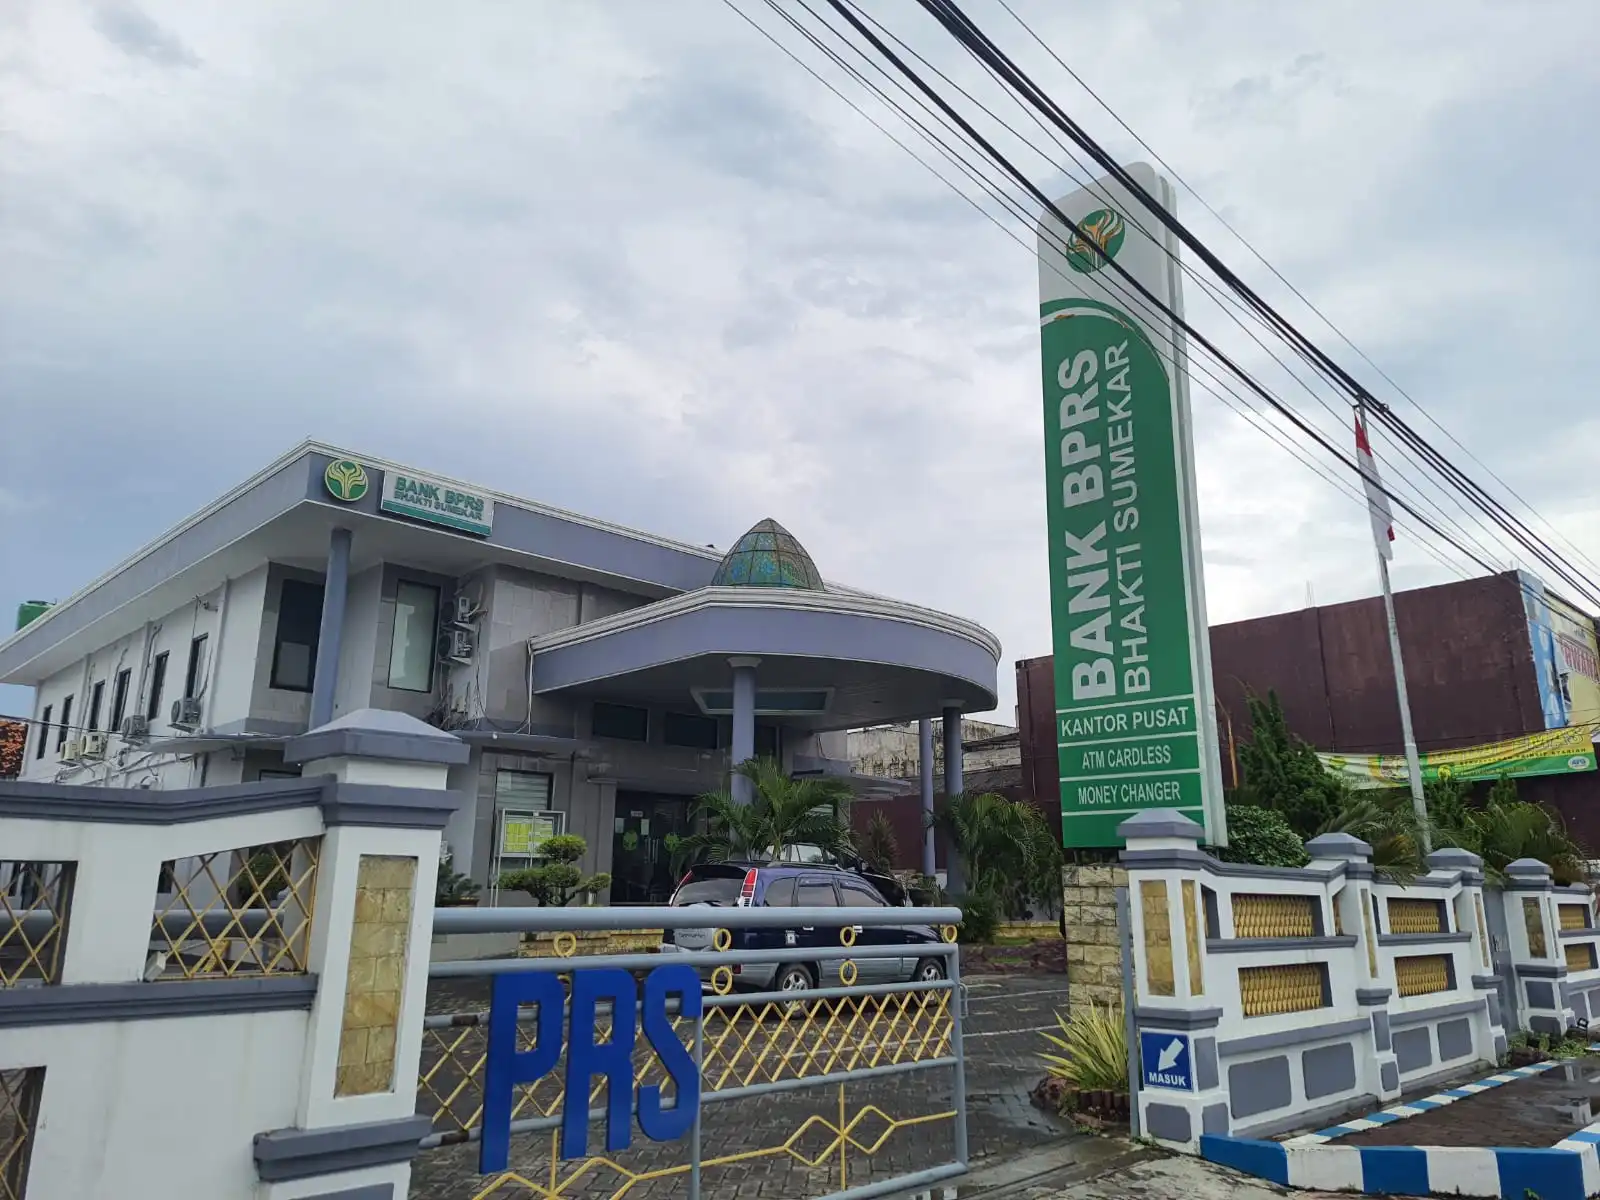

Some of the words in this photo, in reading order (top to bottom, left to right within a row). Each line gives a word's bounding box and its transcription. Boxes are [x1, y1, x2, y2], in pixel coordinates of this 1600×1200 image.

[1057, 349, 1106, 508] BPRS
[1104, 339, 1140, 533] SUMEKAR
[393, 490, 433, 508] BHAKTI
[434, 501, 482, 520] SUMEKAR
[395, 476, 440, 500] BANK
[444, 489, 485, 512] BPRS
[1065, 519, 1117, 700] BANK
[1115, 543, 1151, 694] BHAKTI
[1061, 713, 1128, 737] KANTOR
[1133, 706, 1189, 730] PUSAT
[1081, 750, 1105, 770] ATM
[1107, 744, 1172, 768] CARDLESS
[1078, 784, 1119, 805] MONEY
[1120, 781, 1181, 803] CHANGER
[478, 963, 703, 1175] PRS
[1148, 1071, 1186, 1087] MASUK
